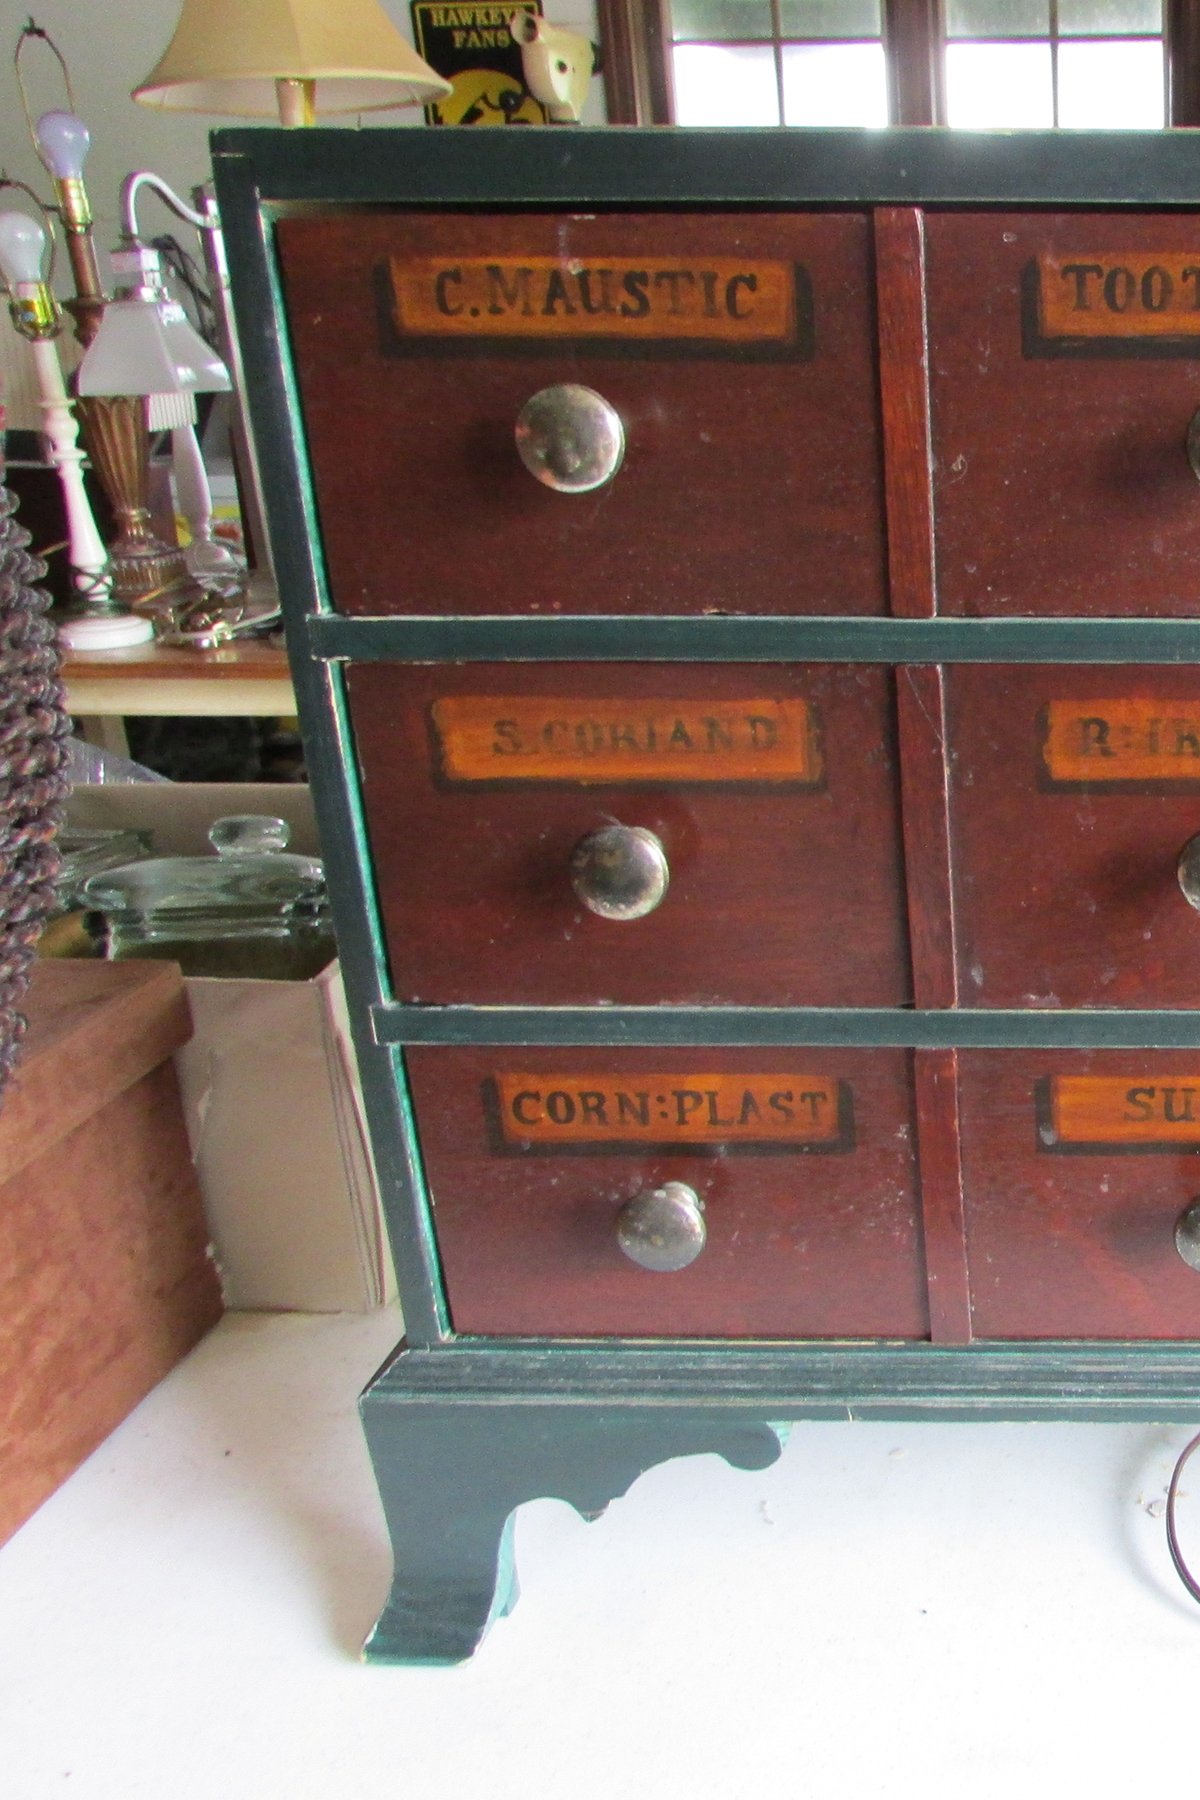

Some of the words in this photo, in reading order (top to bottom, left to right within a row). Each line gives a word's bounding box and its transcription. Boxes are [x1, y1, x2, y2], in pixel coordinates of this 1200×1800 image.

[431, 7, 518, 27] HAWKEY
[452, 29, 511, 48] FANS
[434, 265, 759, 320] C.MAUSTIC
[511, 1089, 829, 1127] CORN:PLAST
